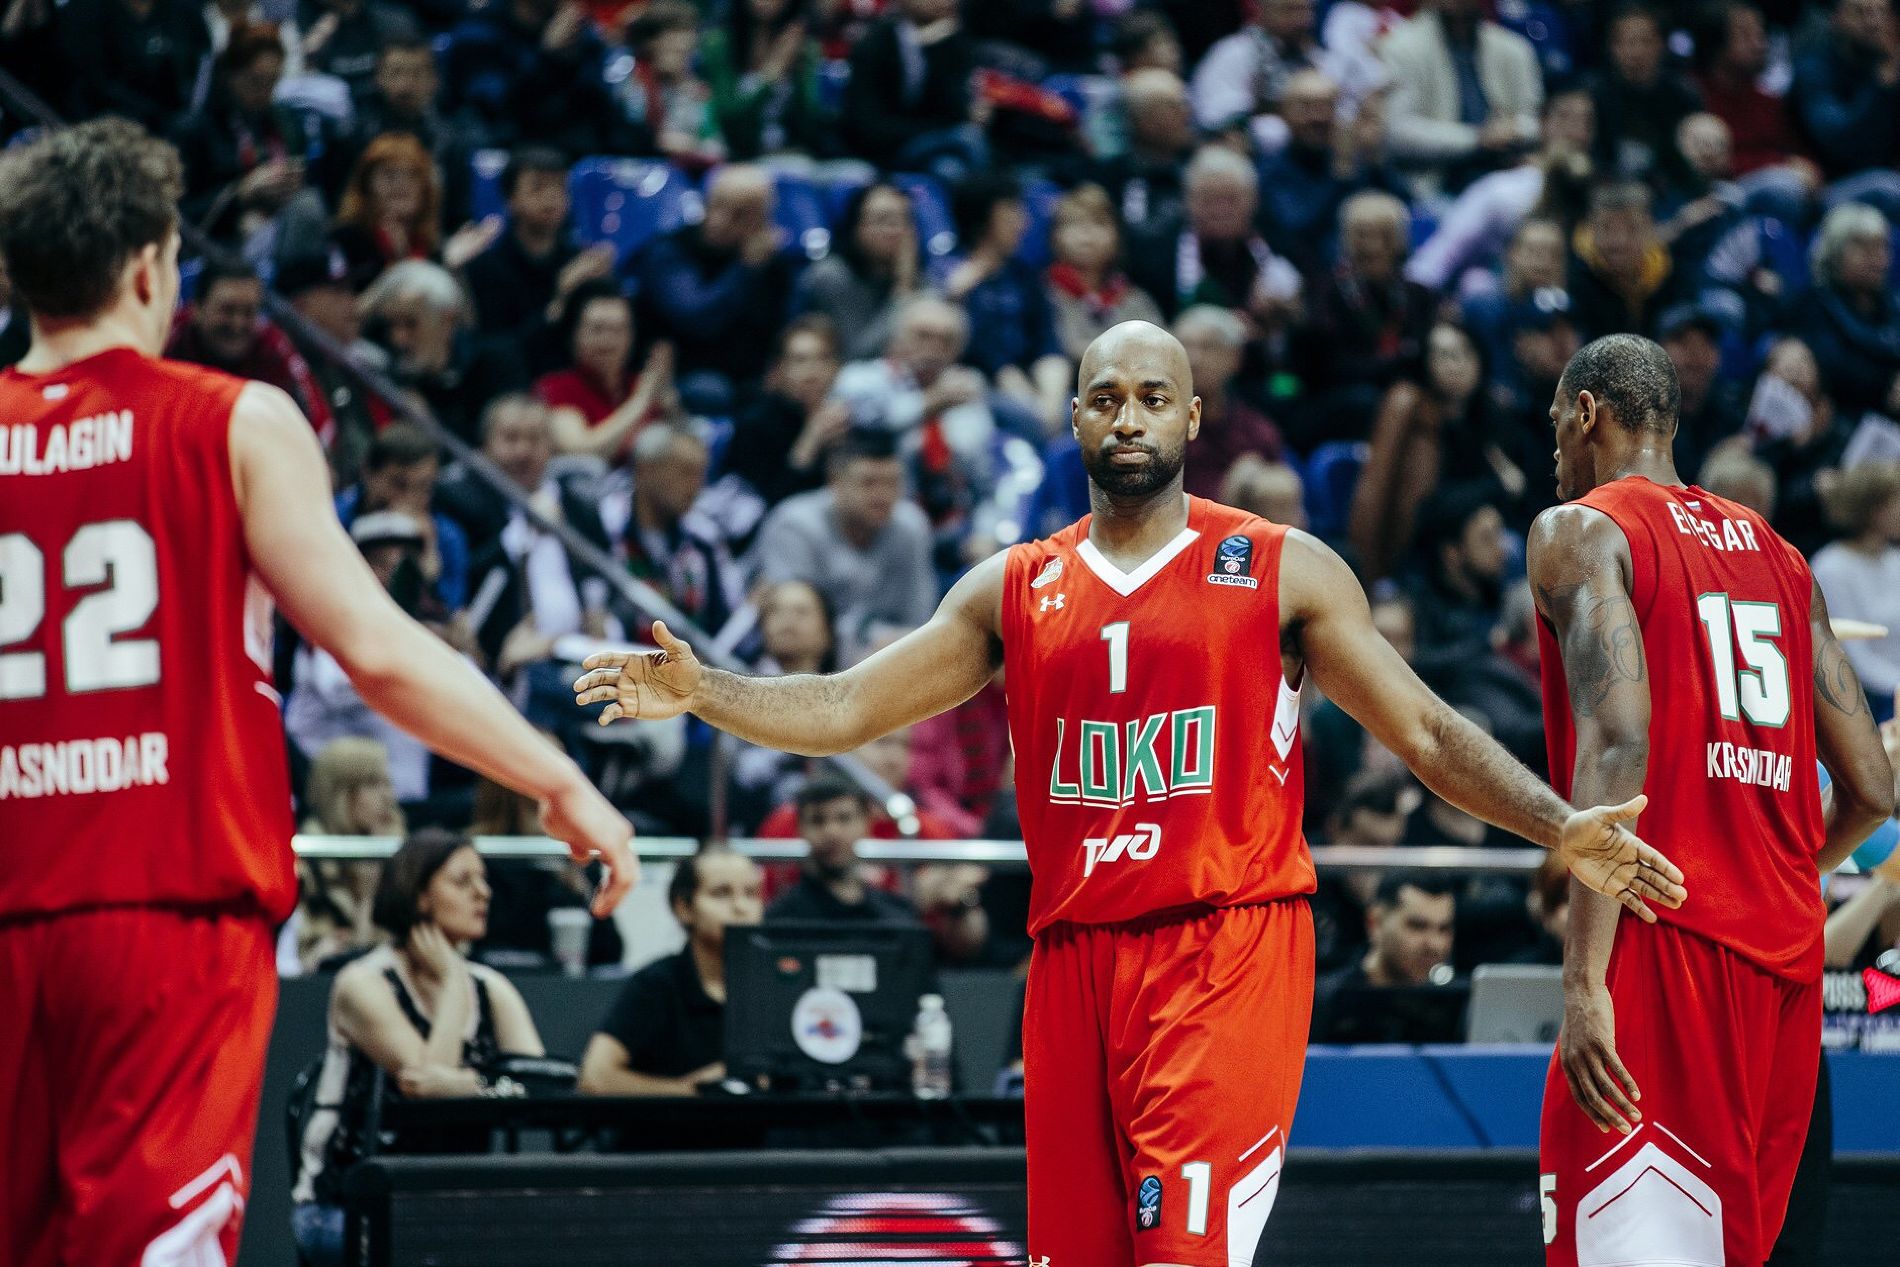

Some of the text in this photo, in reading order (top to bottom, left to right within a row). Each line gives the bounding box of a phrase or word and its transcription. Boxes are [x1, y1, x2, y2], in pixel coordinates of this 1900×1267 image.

[0, 519, 161, 700] 22
[1101, 621, 1130, 693] 1
[1697, 592, 1791, 728] 15
[0, 731, 169, 799] ASNODAR
[1050, 705, 1216, 802] LOKO
[1181, 1161, 1211, 1236] 1
